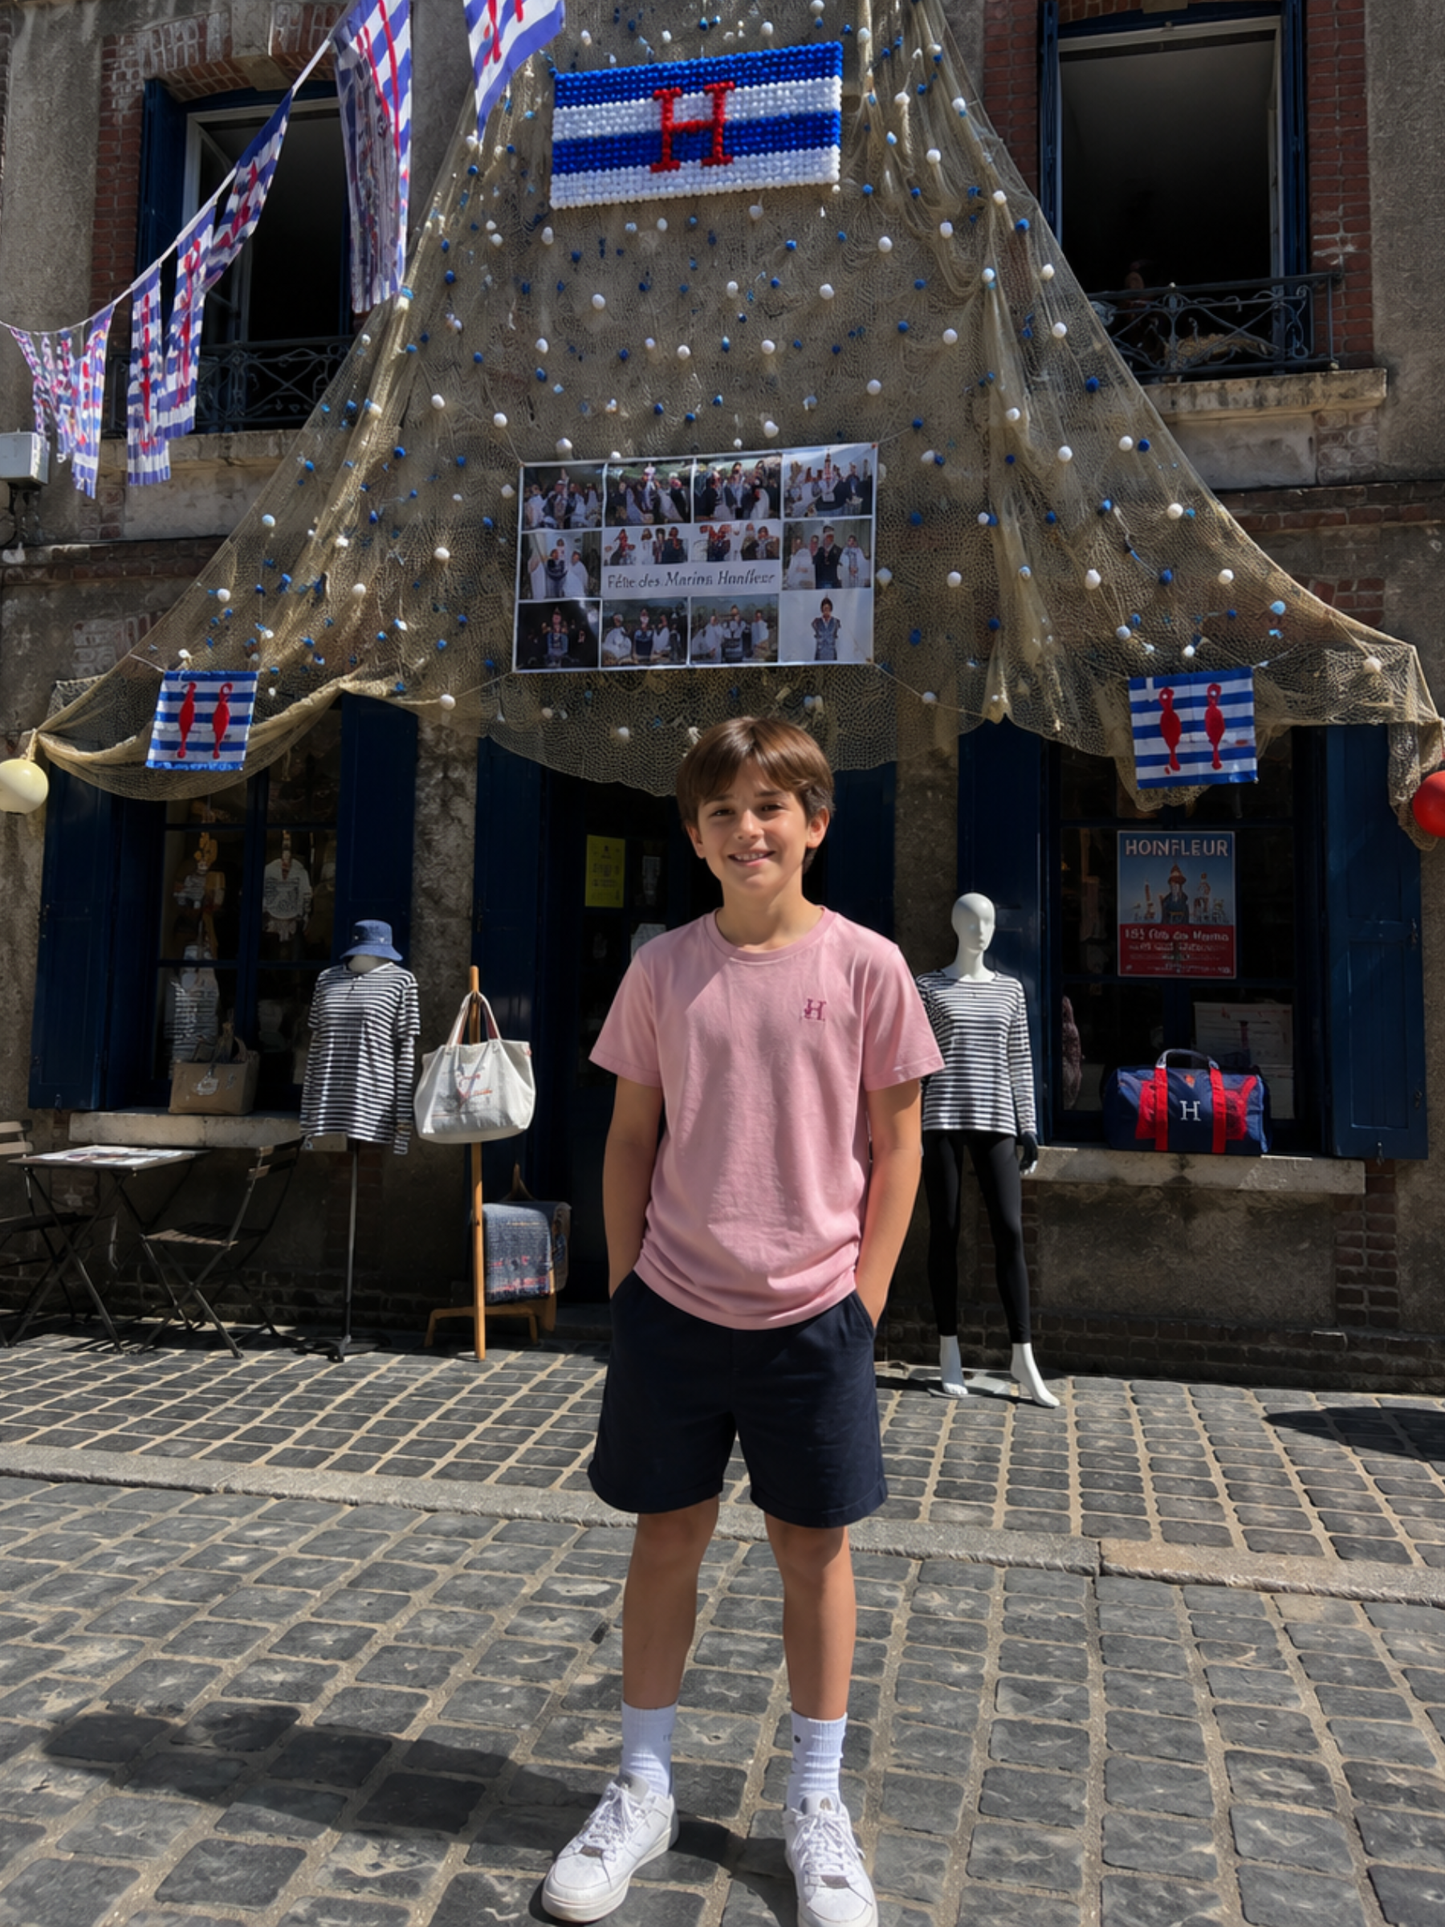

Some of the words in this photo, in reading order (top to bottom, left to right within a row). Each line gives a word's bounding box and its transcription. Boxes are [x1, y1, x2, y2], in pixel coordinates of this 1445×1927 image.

[650, 81, 735, 174] H
[638, 573, 660, 588] des
[1125, 838, 1228, 857] HONFLEUR
[804, 998, 827, 1022] H
[1179, 1100, 1202, 1121] H
